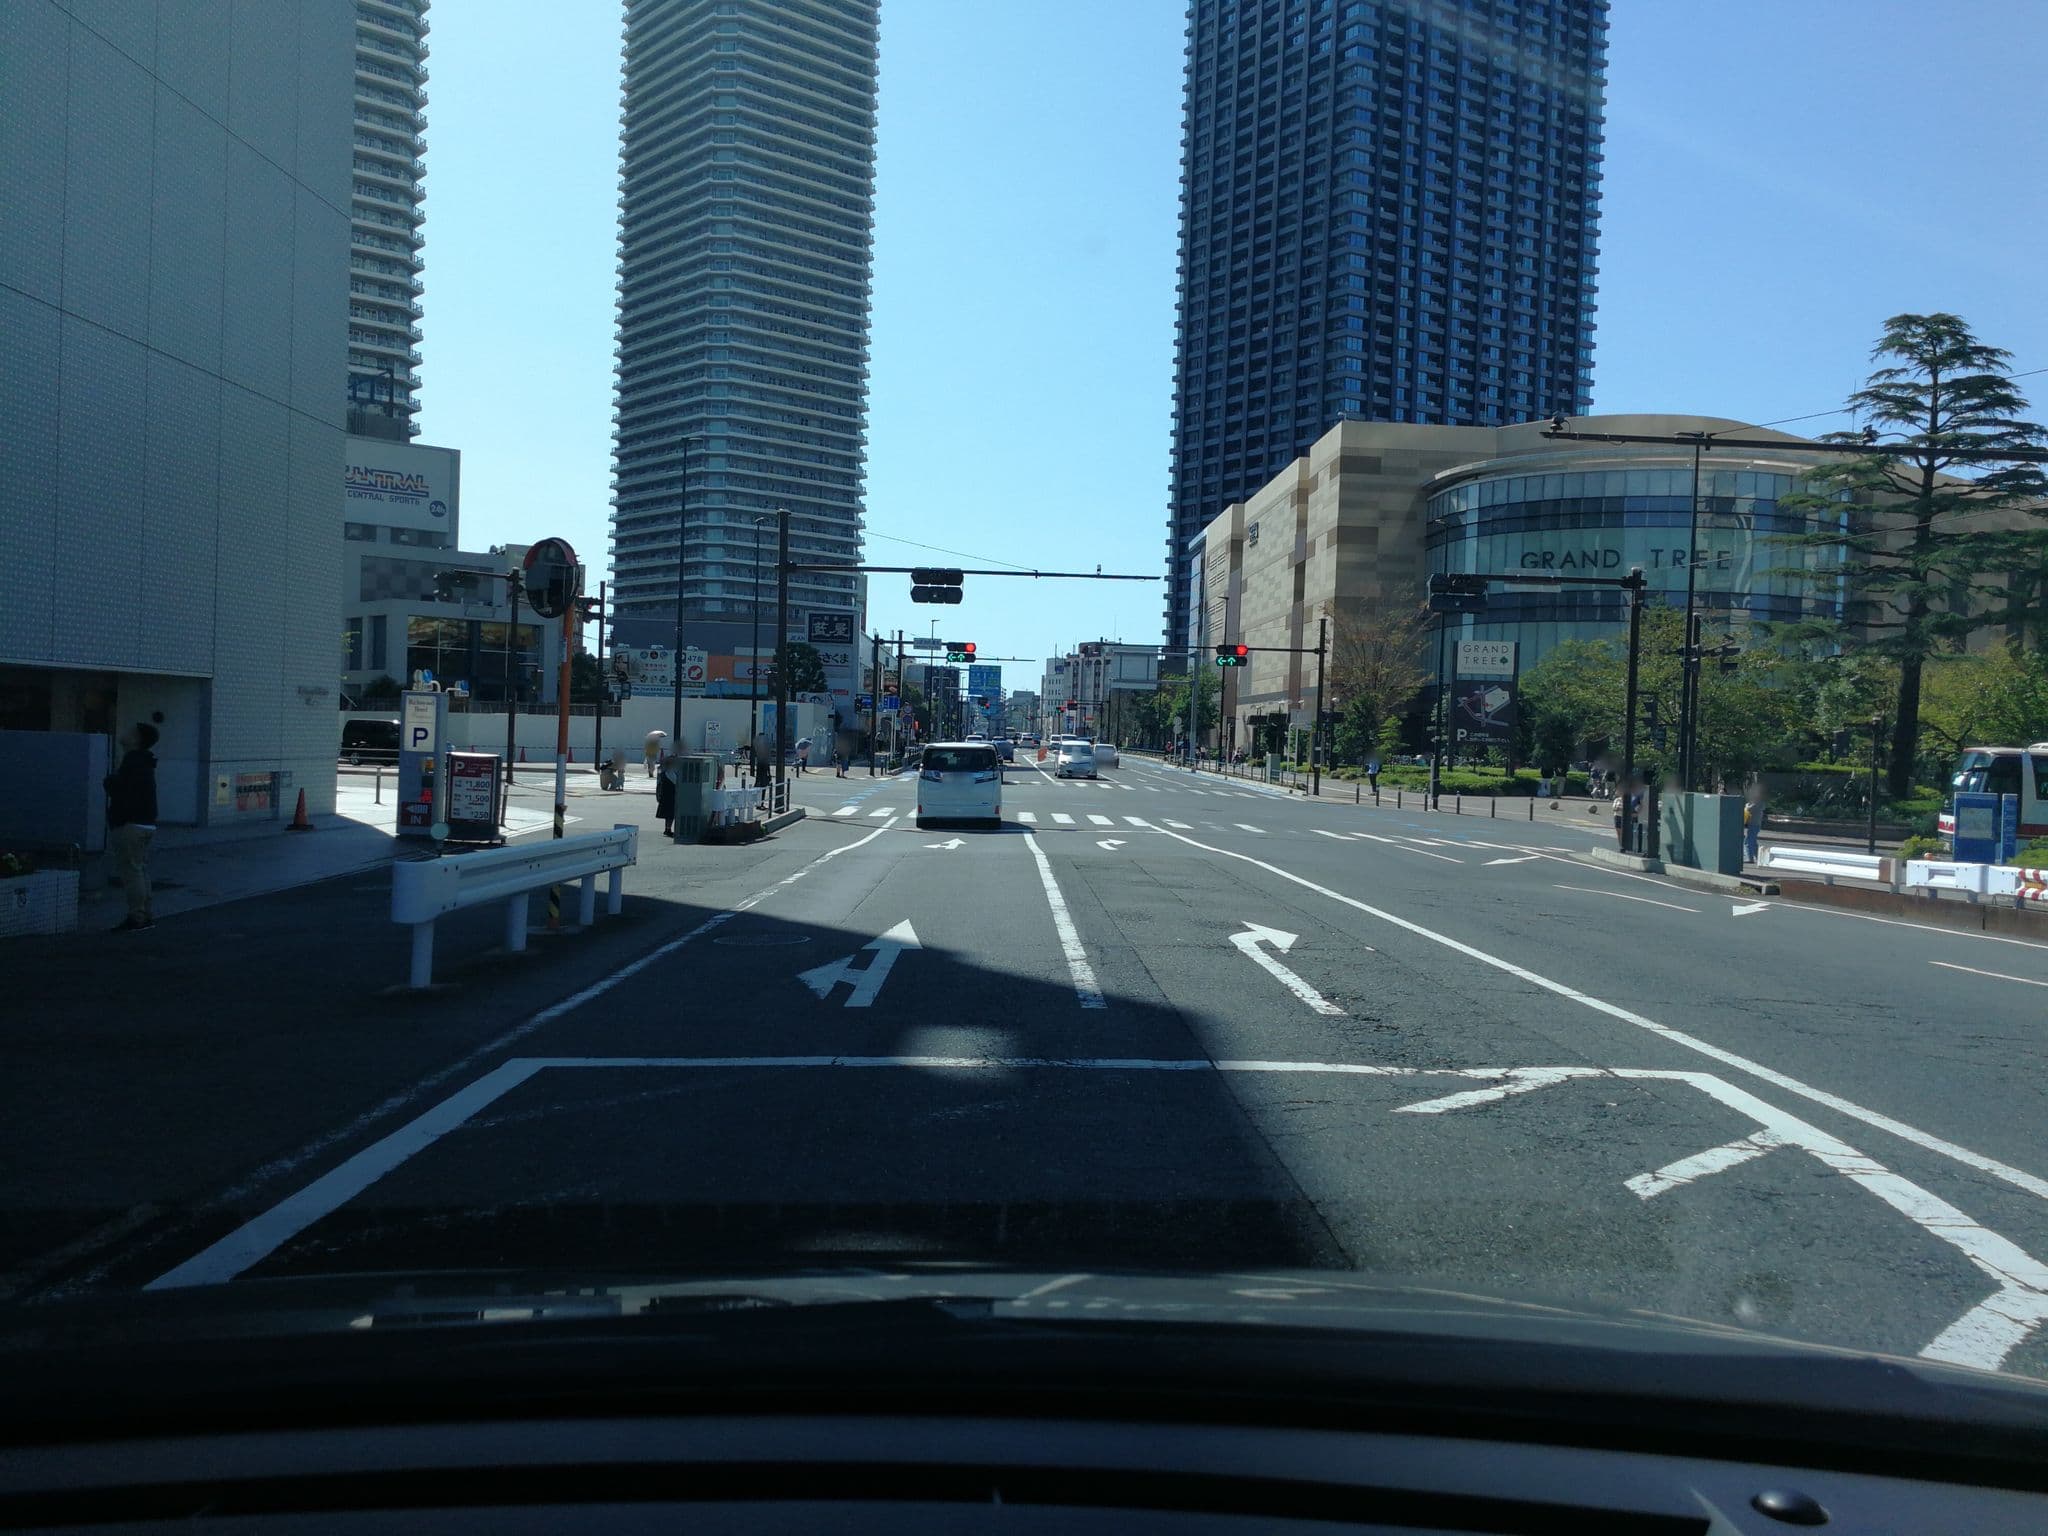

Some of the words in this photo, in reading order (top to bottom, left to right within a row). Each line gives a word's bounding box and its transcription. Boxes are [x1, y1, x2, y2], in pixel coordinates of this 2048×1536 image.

[347, 490, 384, 501] CENTRAL
[389, 495, 421, 505] SPORTS
[1521, 550, 1620, 569] GRAND
[1649, 548, 1731, 571] TREE
[1462, 644, 1510, 655] GRAND
[1463, 655, 1498, 666] TREE
[413, 727, 429, 748] P
[1456, 728, 1468, 742] P
[454, 761, 466, 774] P
[411, 816, 422, 825] IN
